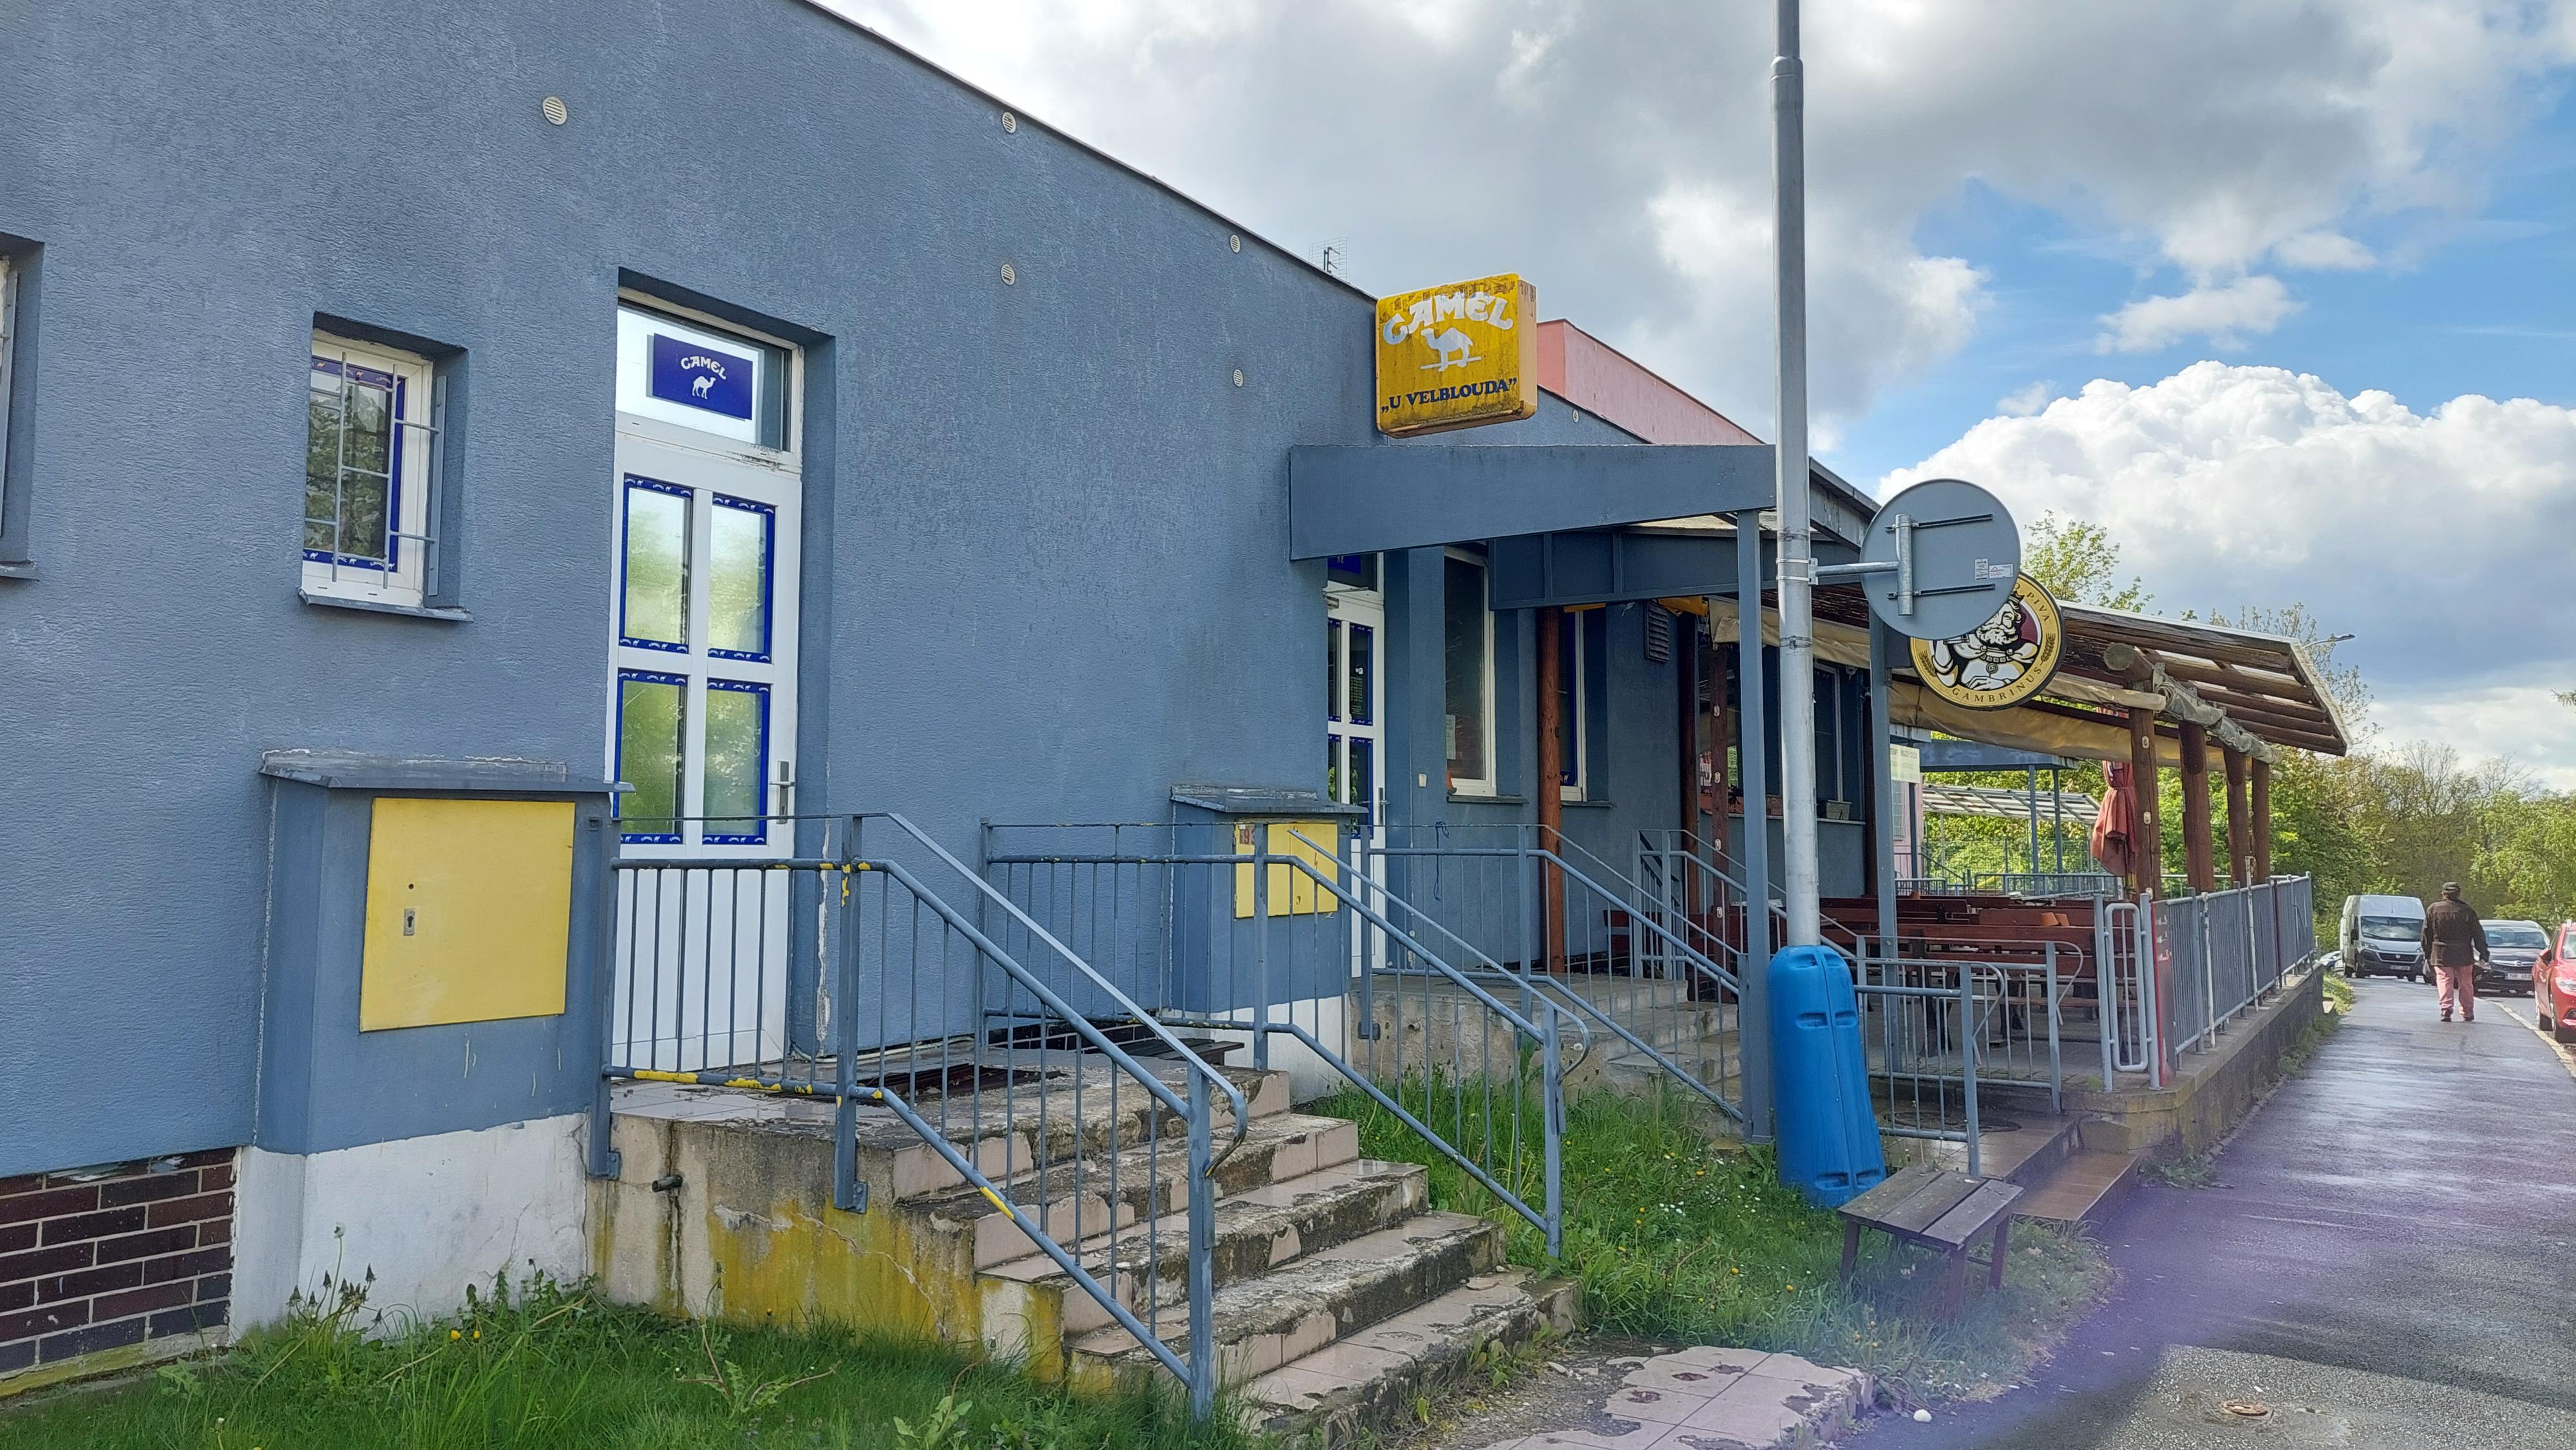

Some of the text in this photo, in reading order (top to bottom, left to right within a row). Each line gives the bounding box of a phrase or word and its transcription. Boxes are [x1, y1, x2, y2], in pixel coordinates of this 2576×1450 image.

[1383, 292, 1513, 344] CAMEL
[681, 355, 726, 380] CAMEL
[2026, 591, 2050, 623] PIVA
[1952, 666, 2042, 702] GAMBRINUS
